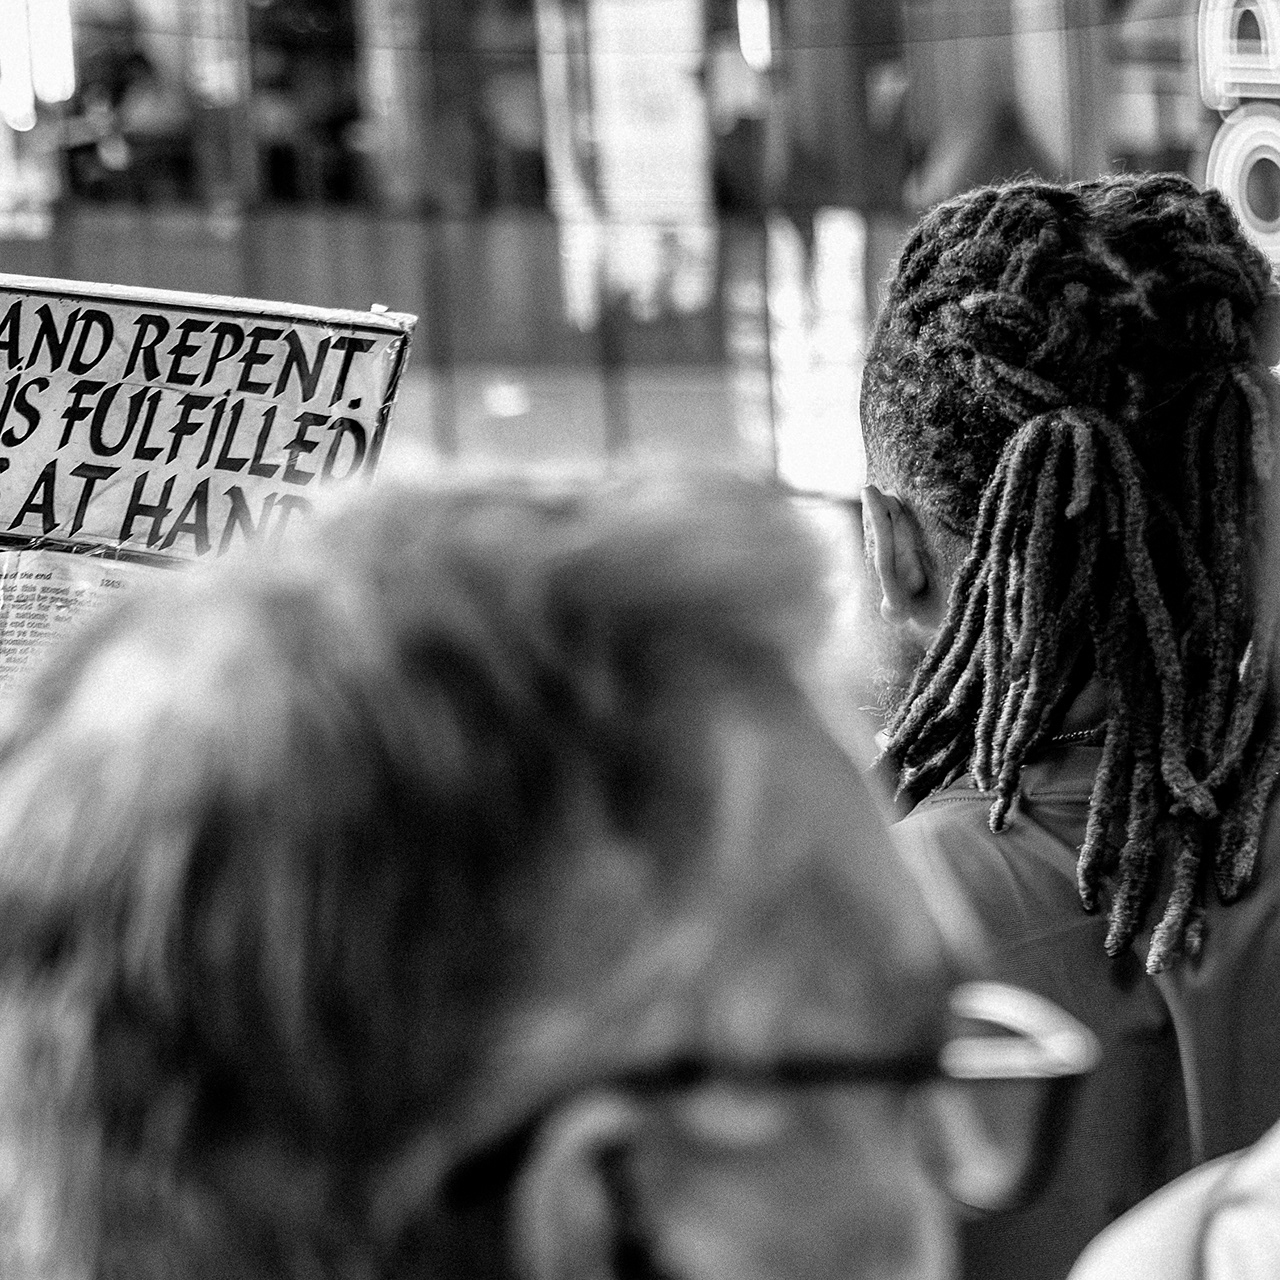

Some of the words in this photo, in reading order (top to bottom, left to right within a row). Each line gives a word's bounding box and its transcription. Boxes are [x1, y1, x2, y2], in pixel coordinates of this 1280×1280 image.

[122, 315, 376, 409] REPENT.
[62, 381, 366, 485] FULFILLED
[24, 459, 121, 536] AT
